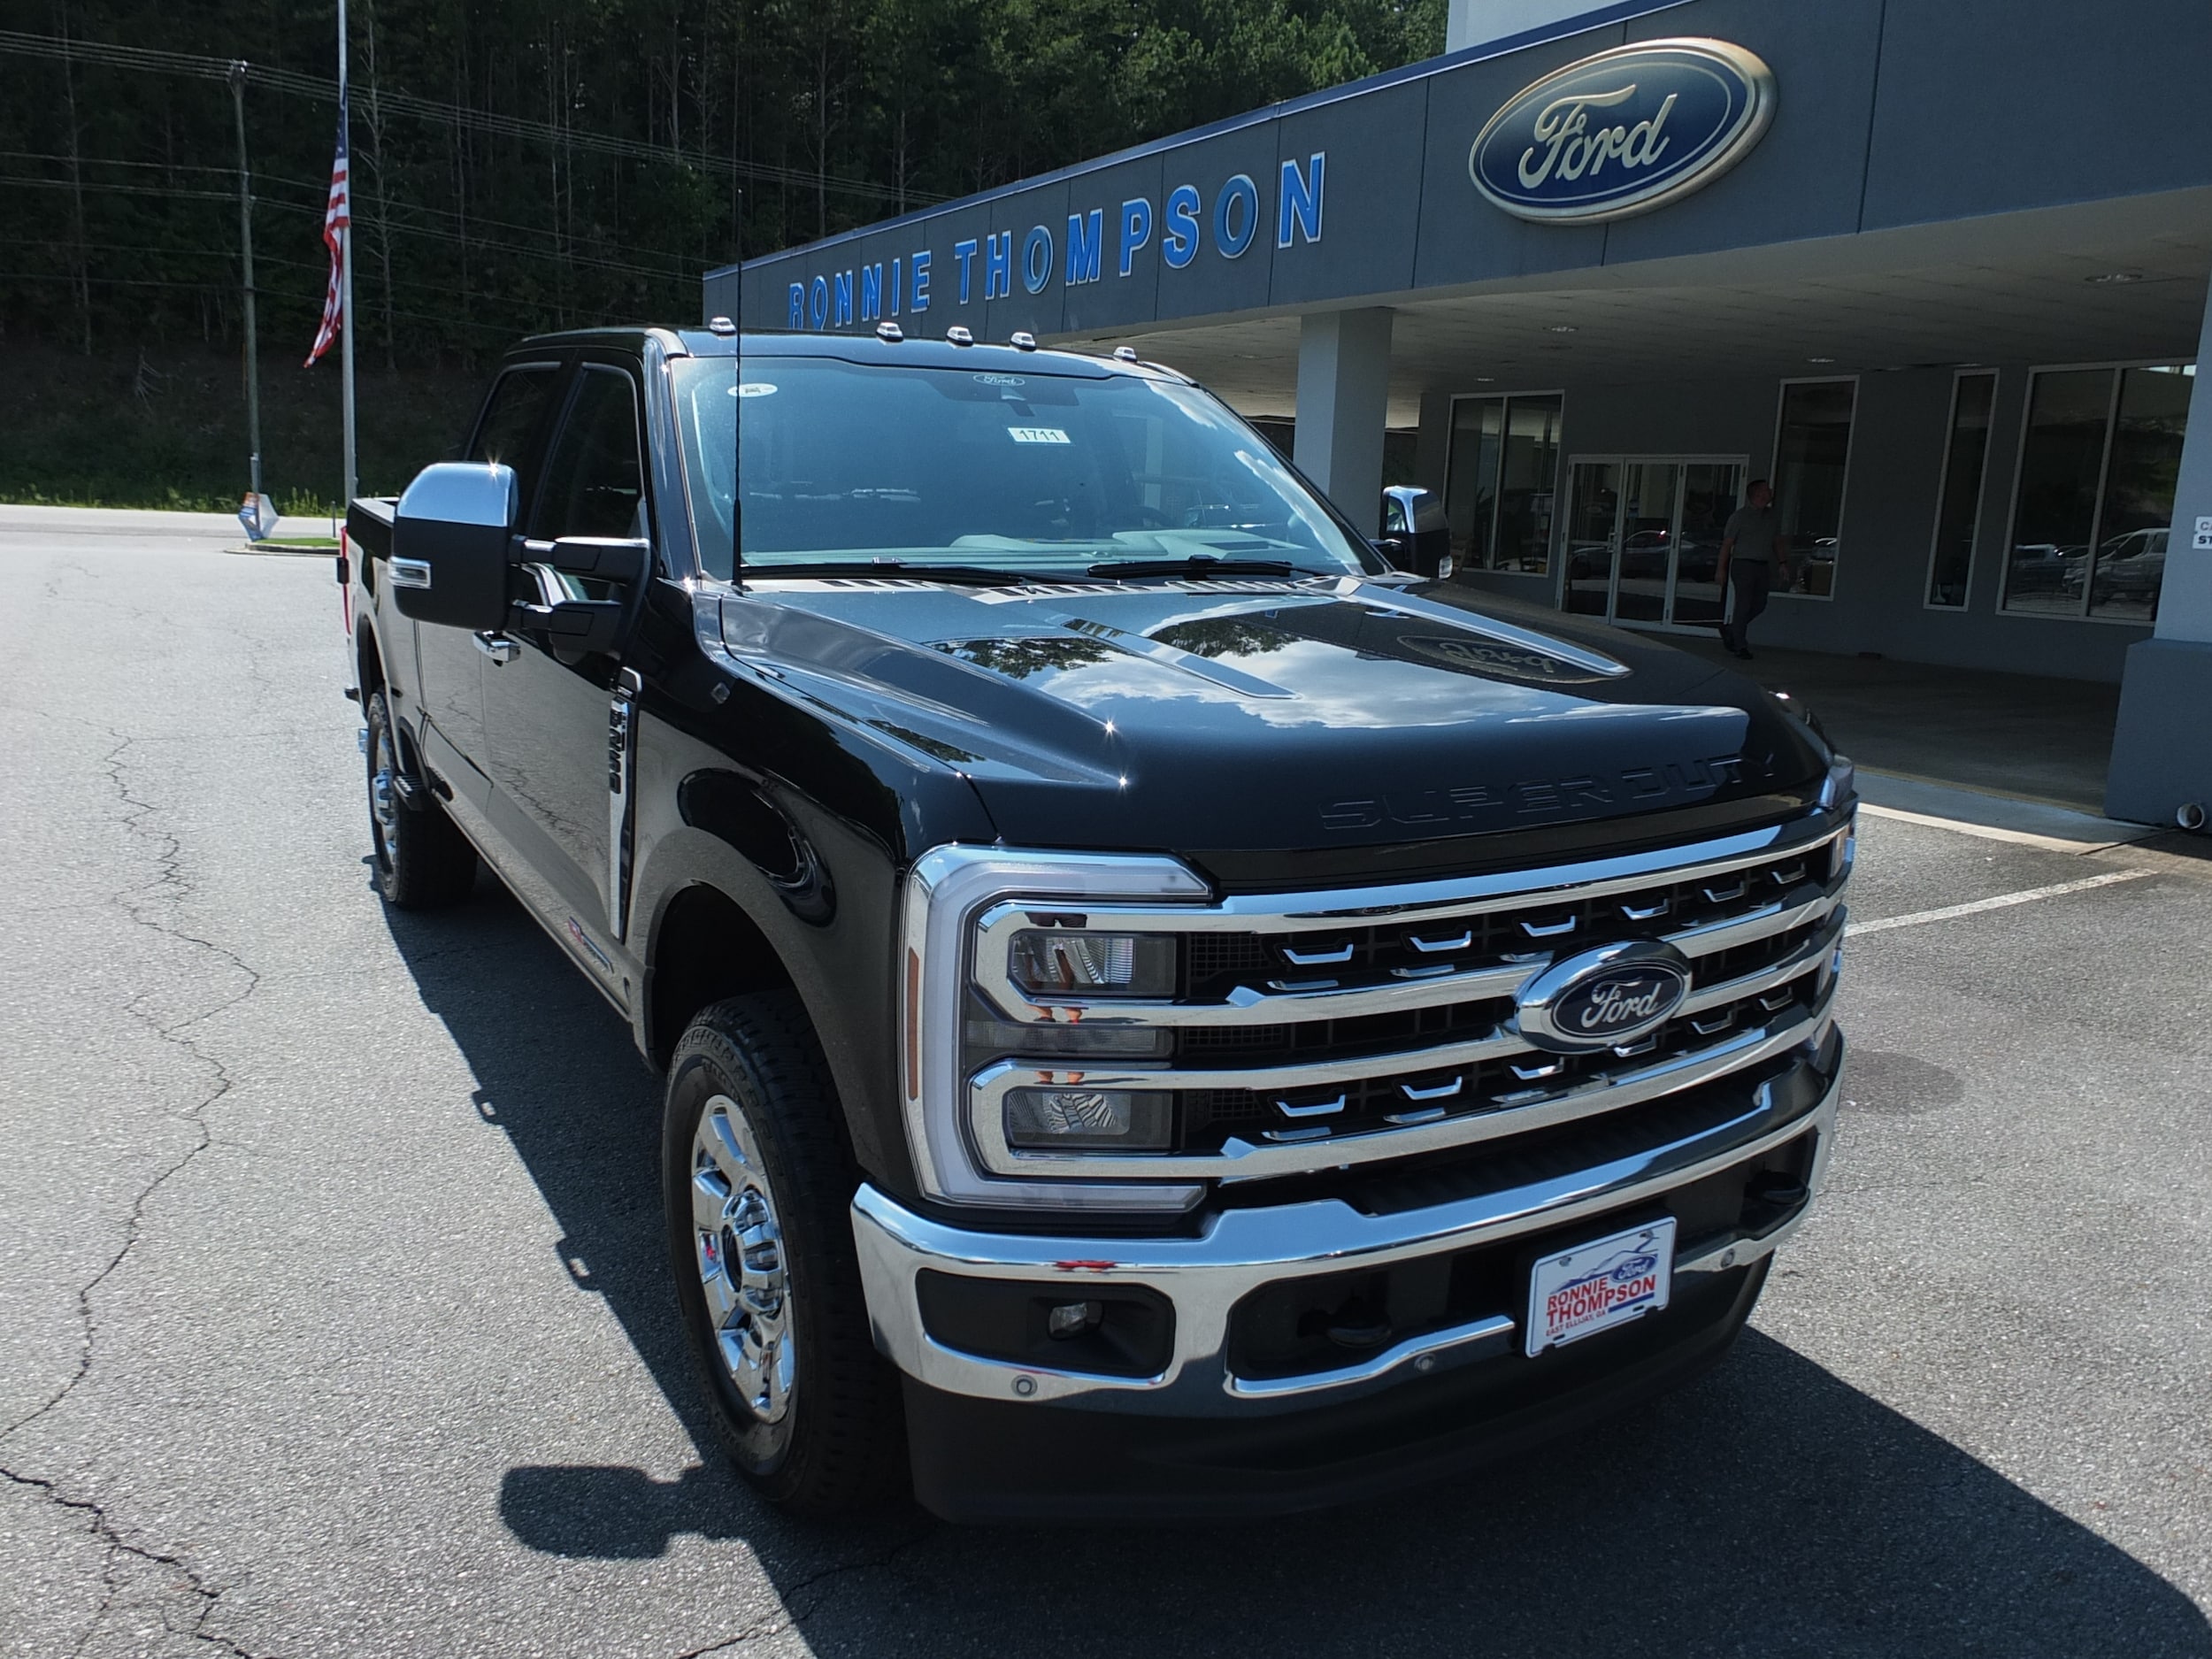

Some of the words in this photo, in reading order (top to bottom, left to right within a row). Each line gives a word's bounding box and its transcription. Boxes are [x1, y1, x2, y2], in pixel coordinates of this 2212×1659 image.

[1517, 83, 1678, 189] Ford
[788, 249, 932, 330] RONNIE
[954, 151, 1326, 304] THOMPSON
[983, 375, 1017, 386] Ford
[1019, 429, 1060, 442] 1711
[1318, 773, 1613, 831] SUPER
[1623, 751, 1776, 800] DUTY
[1580, 976, 1663, 1028] Ford
[1618, 1258, 1650, 1279] Ford
[1546, 1274, 1656, 1327] THOMPSON
[1547, 1277, 1609, 1310] RONNIE
[1546, 1325, 1563, 1337] EAST
